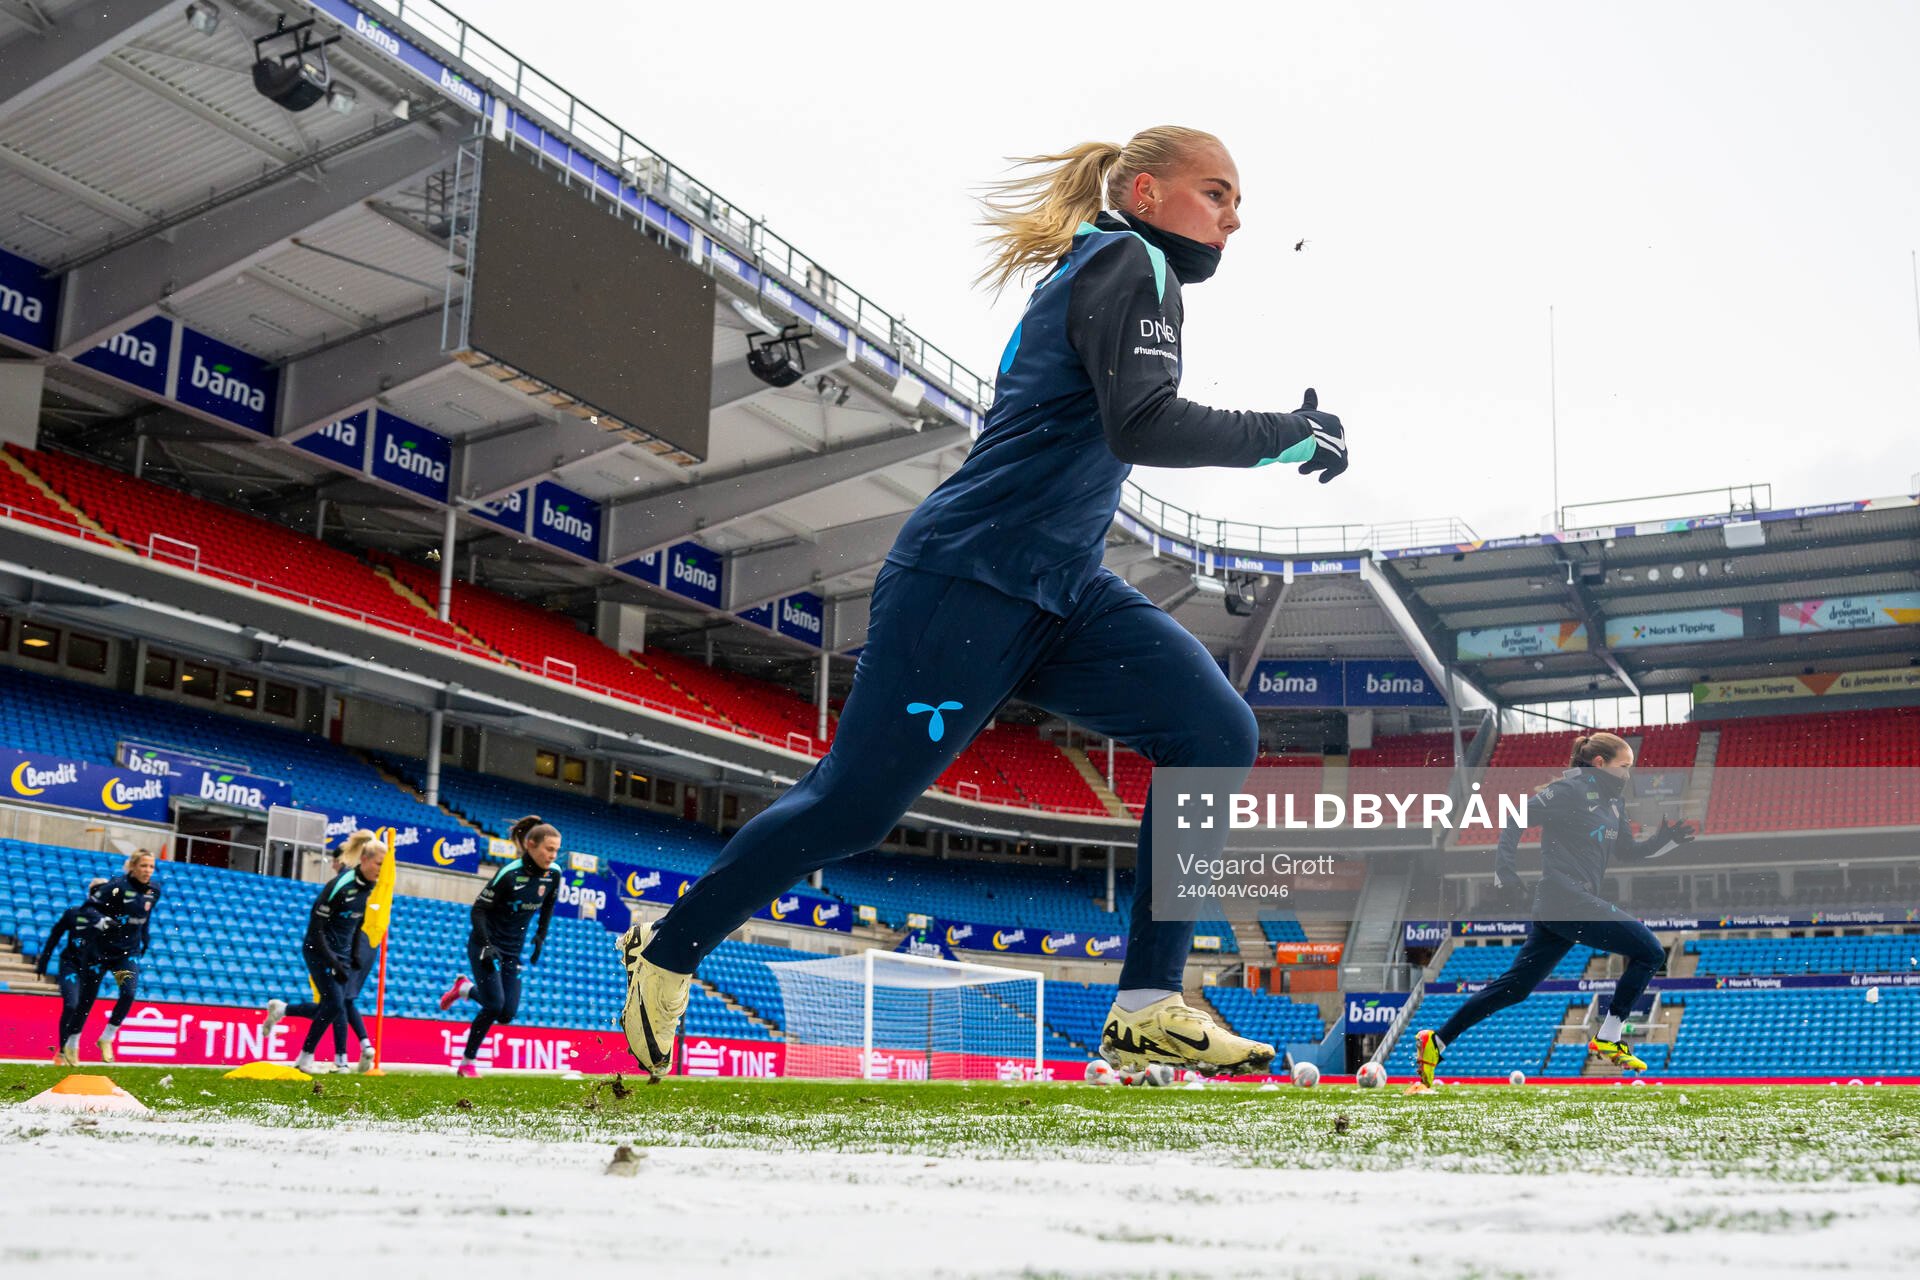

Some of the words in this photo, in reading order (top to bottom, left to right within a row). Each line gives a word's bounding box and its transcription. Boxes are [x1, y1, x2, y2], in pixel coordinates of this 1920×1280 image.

[356, 12, 399, 55] bama
[441, 67, 481, 108] bama
[0, 284, 42, 323] ma
[1140, 316, 1176, 343] DNB
[97, 332, 157, 367] ma
[191, 355, 265, 412] bama
[385, 434, 445, 483] bama
[542, 499, 593, 542] bama
[673, 554, 718, 592] bama
[783, 598, 820, 633] bama
[1649, 626, 1677, 637] Norsk
[1679, 622, 1716, 634] Tipping
[1258, 671, 1318, 693] bama
[1366, 672, 1424, 694] bama
[26, 763, 78, 788] Bendit
[116, 779, 163, 803] Bendit
[201, 771, 261, 808] bama
[326, 815, 357, 836] endit
[442, 837, 477, 858] Bendit
[558, 877, 606, 910] bama
[1406, 924, 1449, 940] bama
[1474, 923, 1496, 932] Norsk
[1497, 922, 1526, 934] Tipping
[1668, 917, 1699, 928] Tipping
[1758, 914, 1790, 926] Tipping
[1728, 979, 1750, 988] Norsk
[1751, 978, 1782, 989] Tipping
[1349, 1001, 1402, 1023] bam
[200, 1020, 290, 1060] TINE
[507, 1038, 572, 1070] TINE
[728, 1050, 777, 1077] TINE
